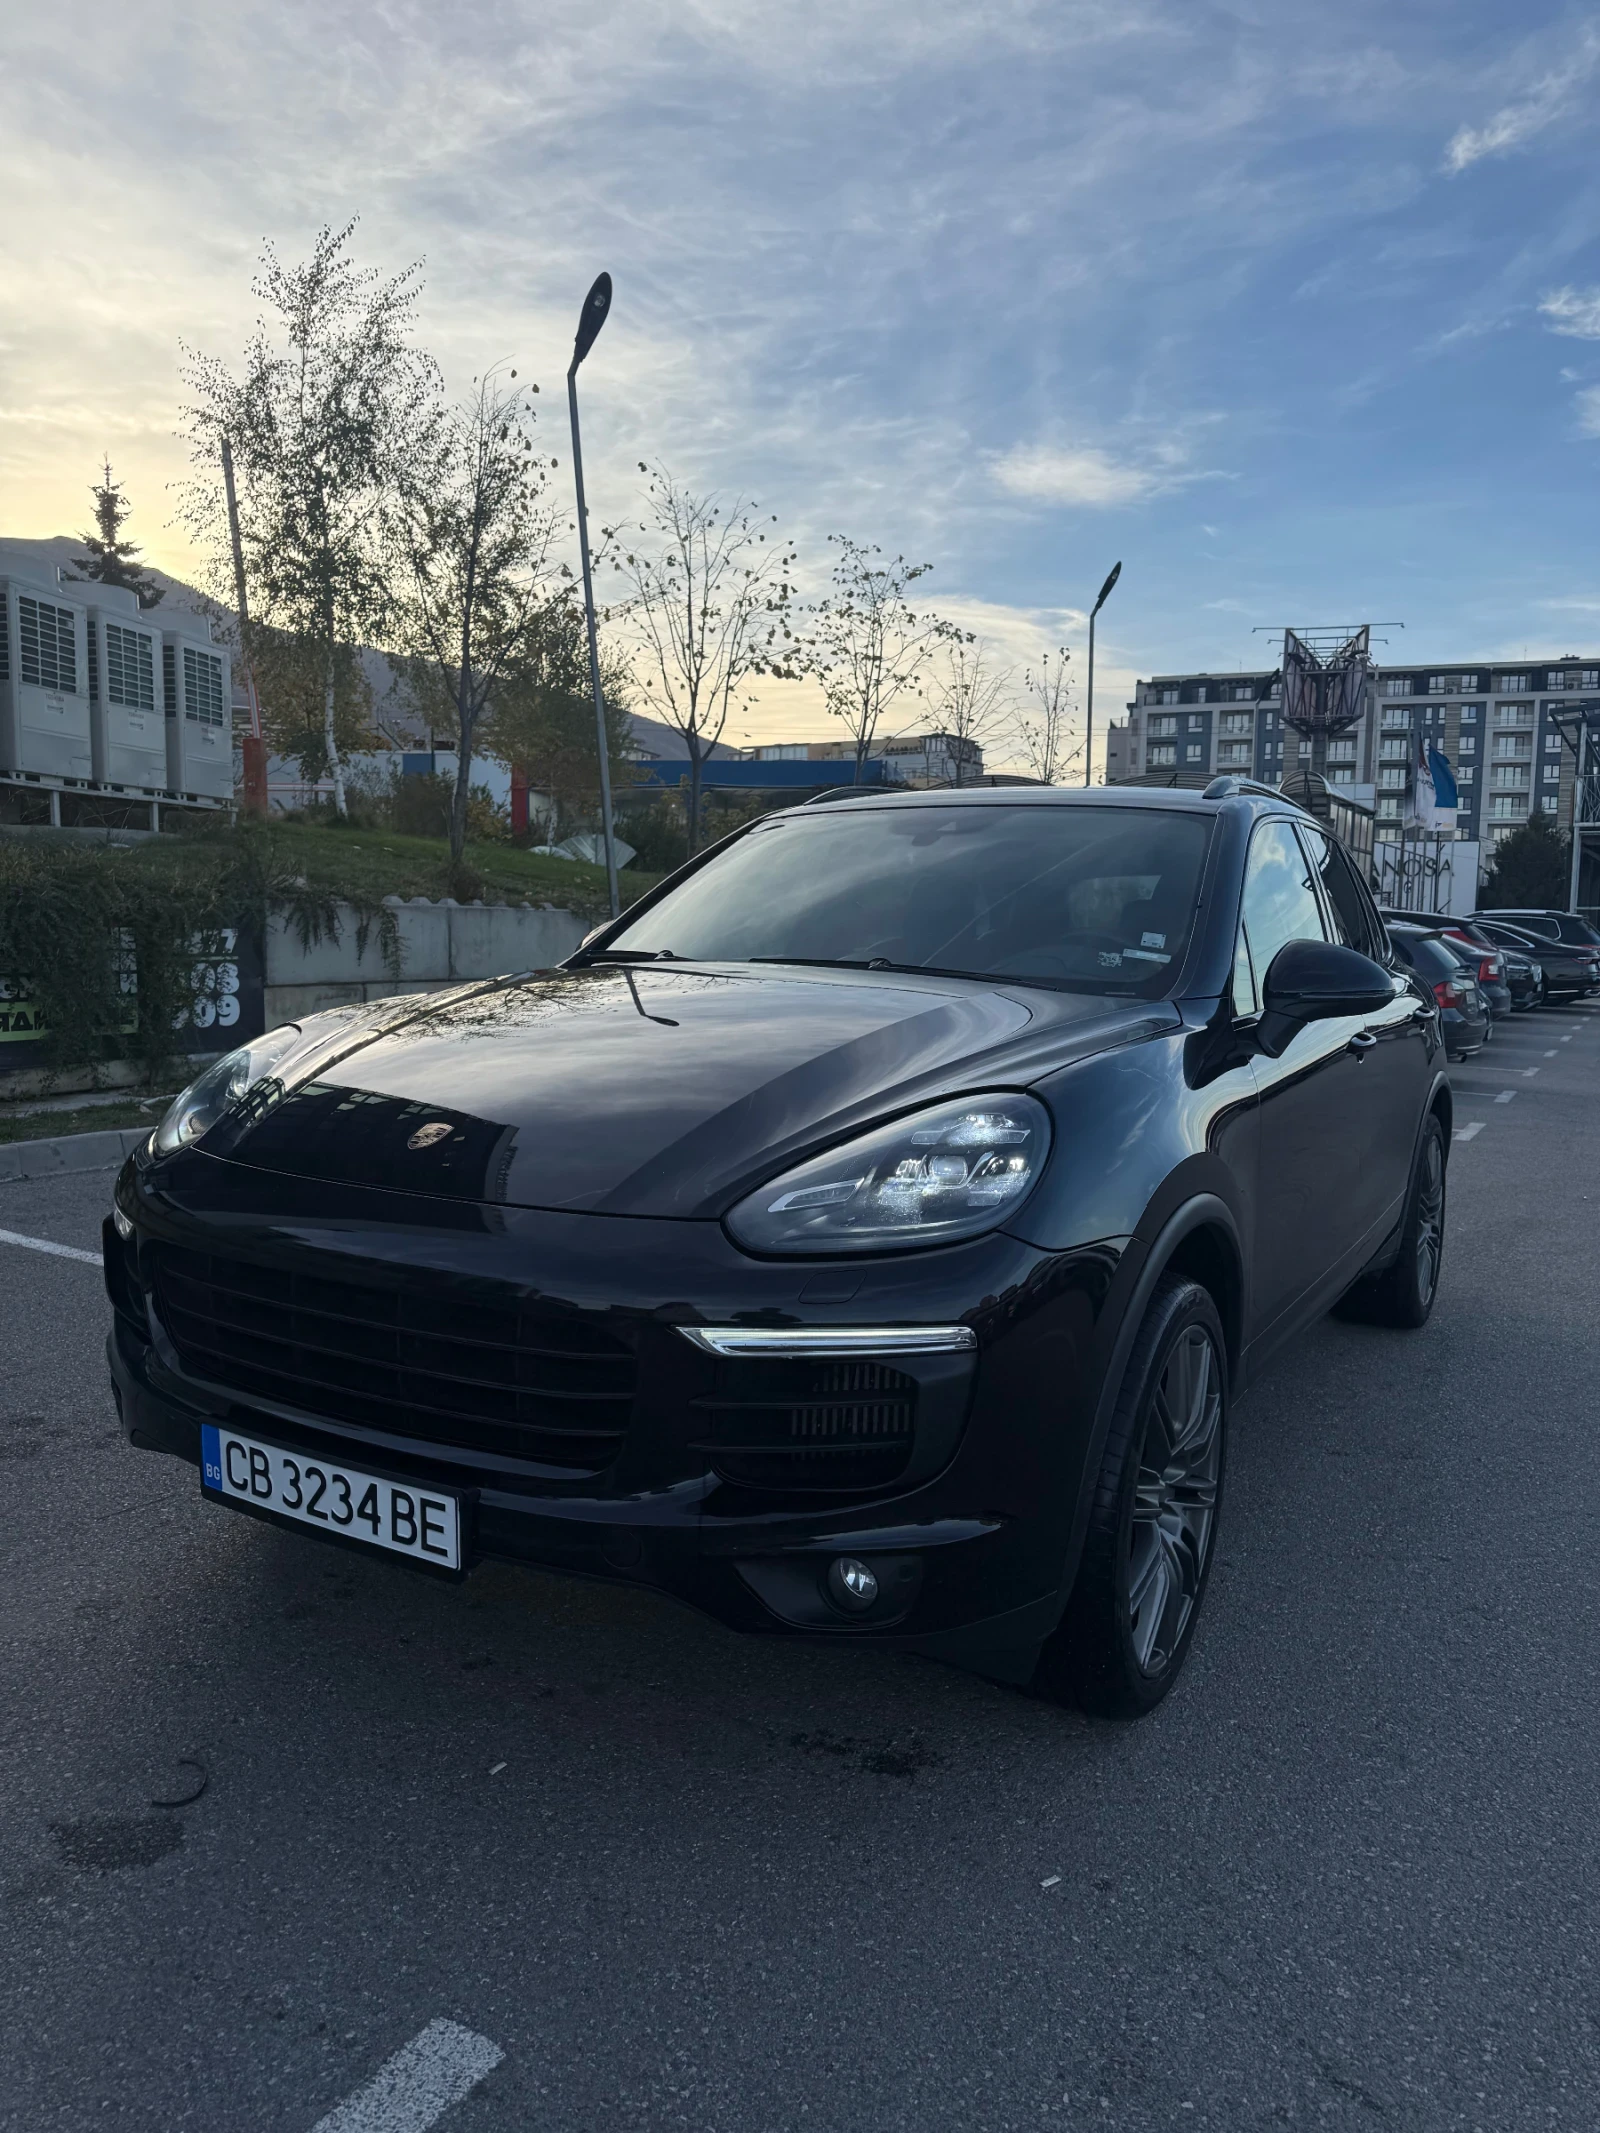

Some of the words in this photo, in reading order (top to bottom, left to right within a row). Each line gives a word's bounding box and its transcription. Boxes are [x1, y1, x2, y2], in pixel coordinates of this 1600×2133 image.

[205, 1462, 221, 1481] BG
[226, 1440, 273, 1499] CB
[282, 1458, 381, 1536] 3234
[391, 1488, 448, 1558] BE
